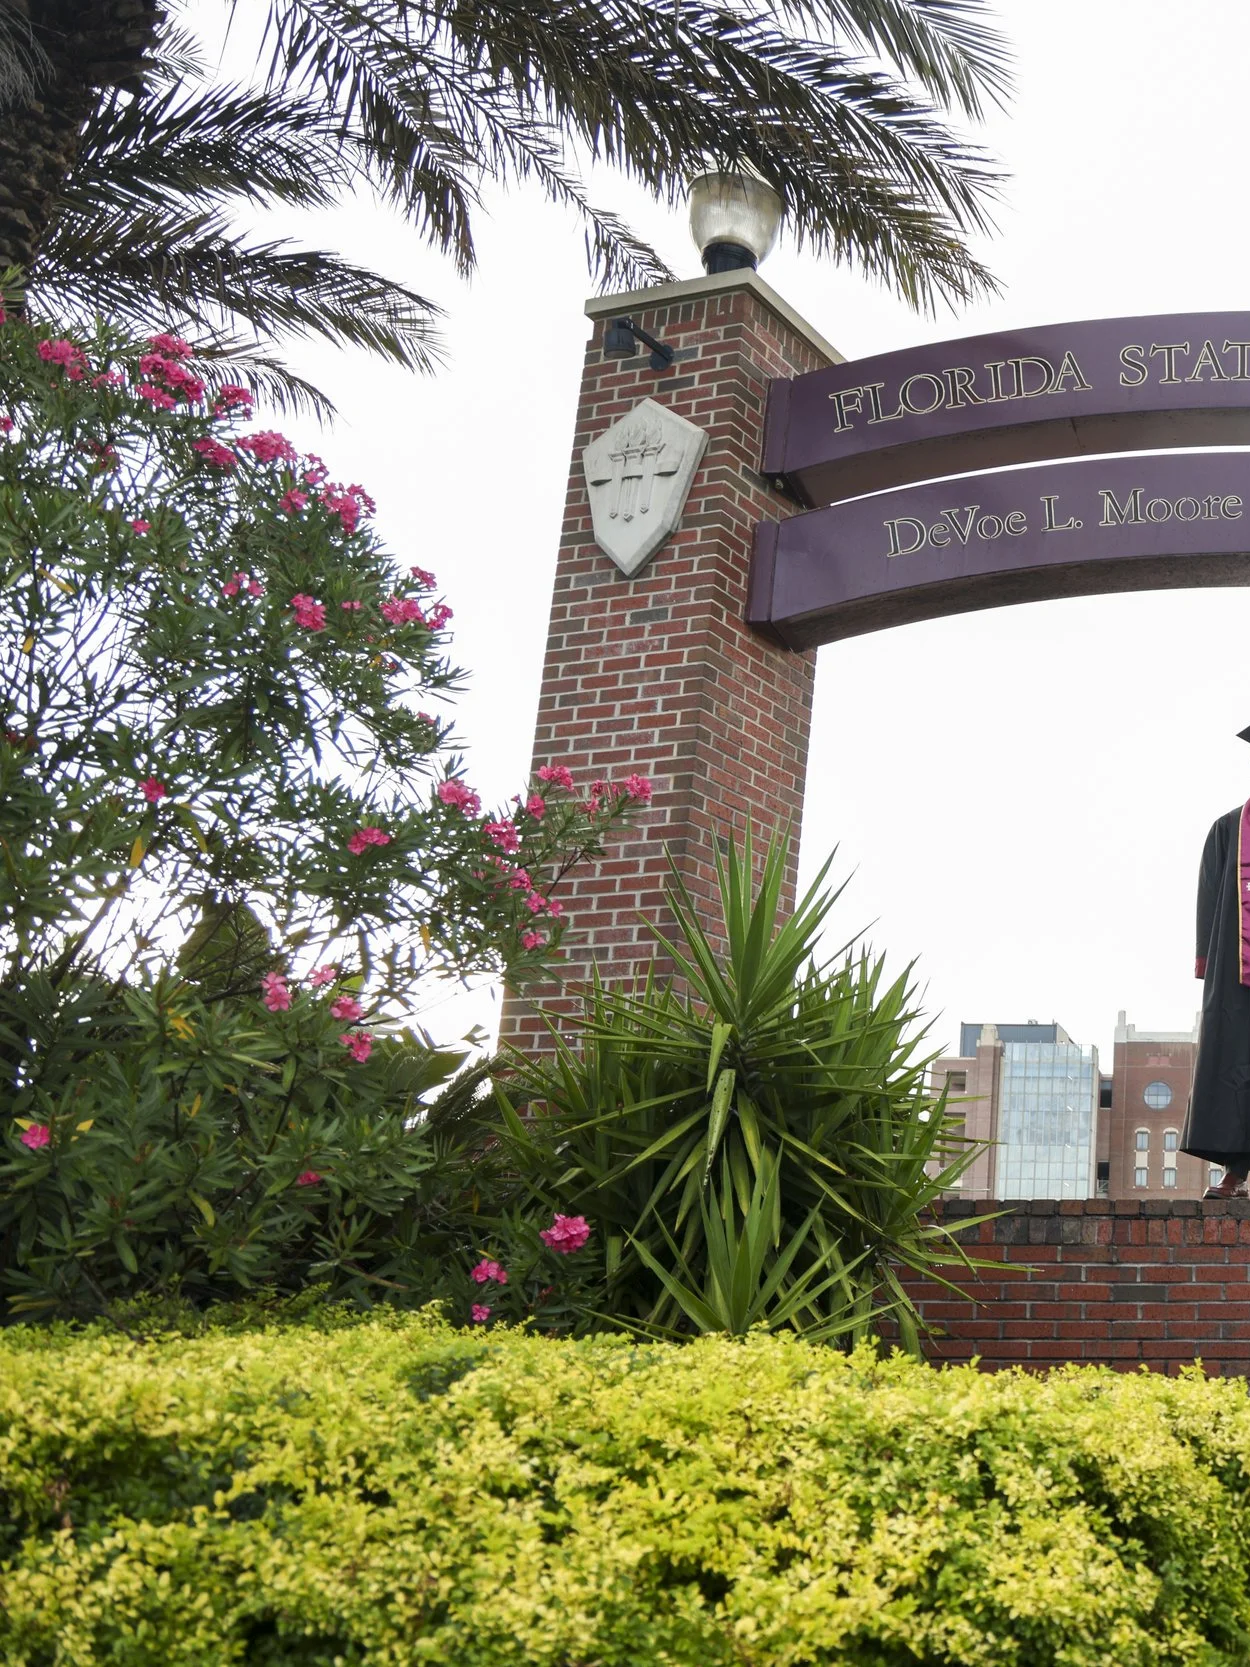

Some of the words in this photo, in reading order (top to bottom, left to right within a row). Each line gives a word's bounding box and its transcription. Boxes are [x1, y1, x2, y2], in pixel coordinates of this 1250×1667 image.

[829, 351, 1092, 433] FLORIDA
[883, 504, 1027, 557] DeVoe
[1040, 495, 1083, 531] L.
[1098, 488, 1243, 526] Moore
